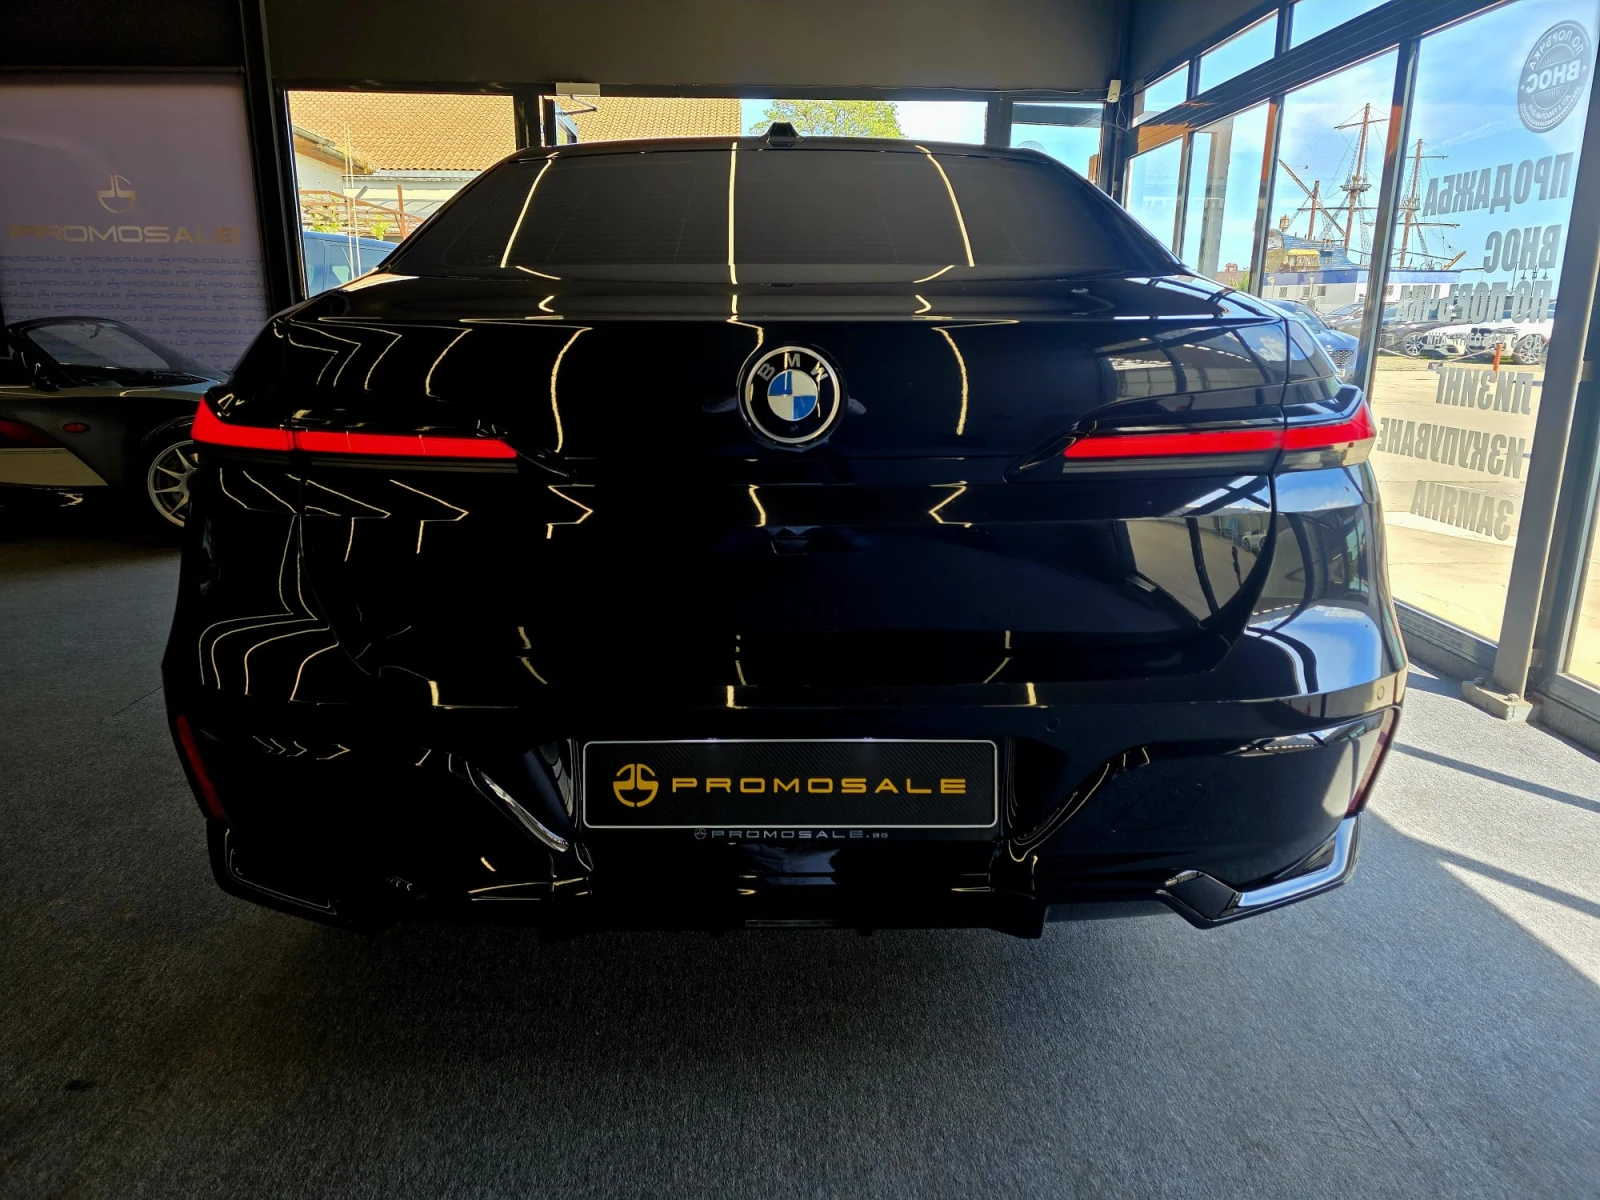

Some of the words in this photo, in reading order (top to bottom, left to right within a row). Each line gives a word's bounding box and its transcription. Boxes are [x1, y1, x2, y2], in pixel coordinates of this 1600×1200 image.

[9, 225, 241, 244] PROMOSALE
[757, 352, 829, 382] BMW
[672, 777, 966, 795] PROMOSALE
